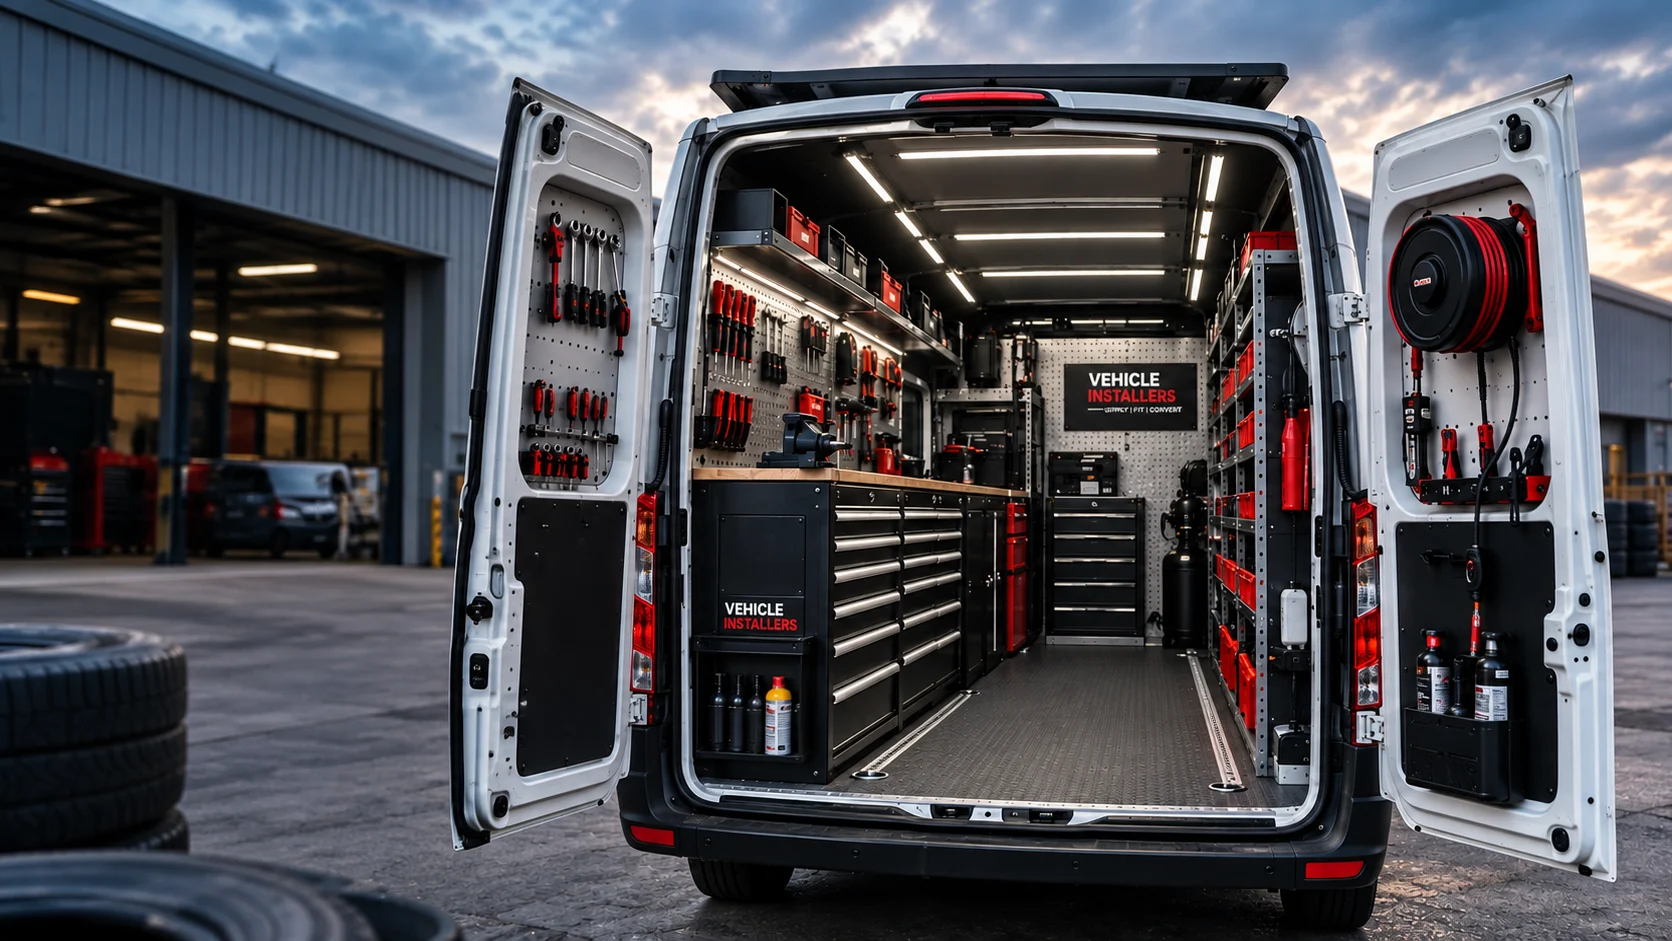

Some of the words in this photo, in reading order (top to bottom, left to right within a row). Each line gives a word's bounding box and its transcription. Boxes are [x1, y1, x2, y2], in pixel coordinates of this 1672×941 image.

[1088, 372, 1160, 387] VEHICLE
[1087, 389, 1176, 403] INSTALLERS
[724, 602, 784, 616] VEHICLE
[723, 617, 798, 631] INSTALLERS
